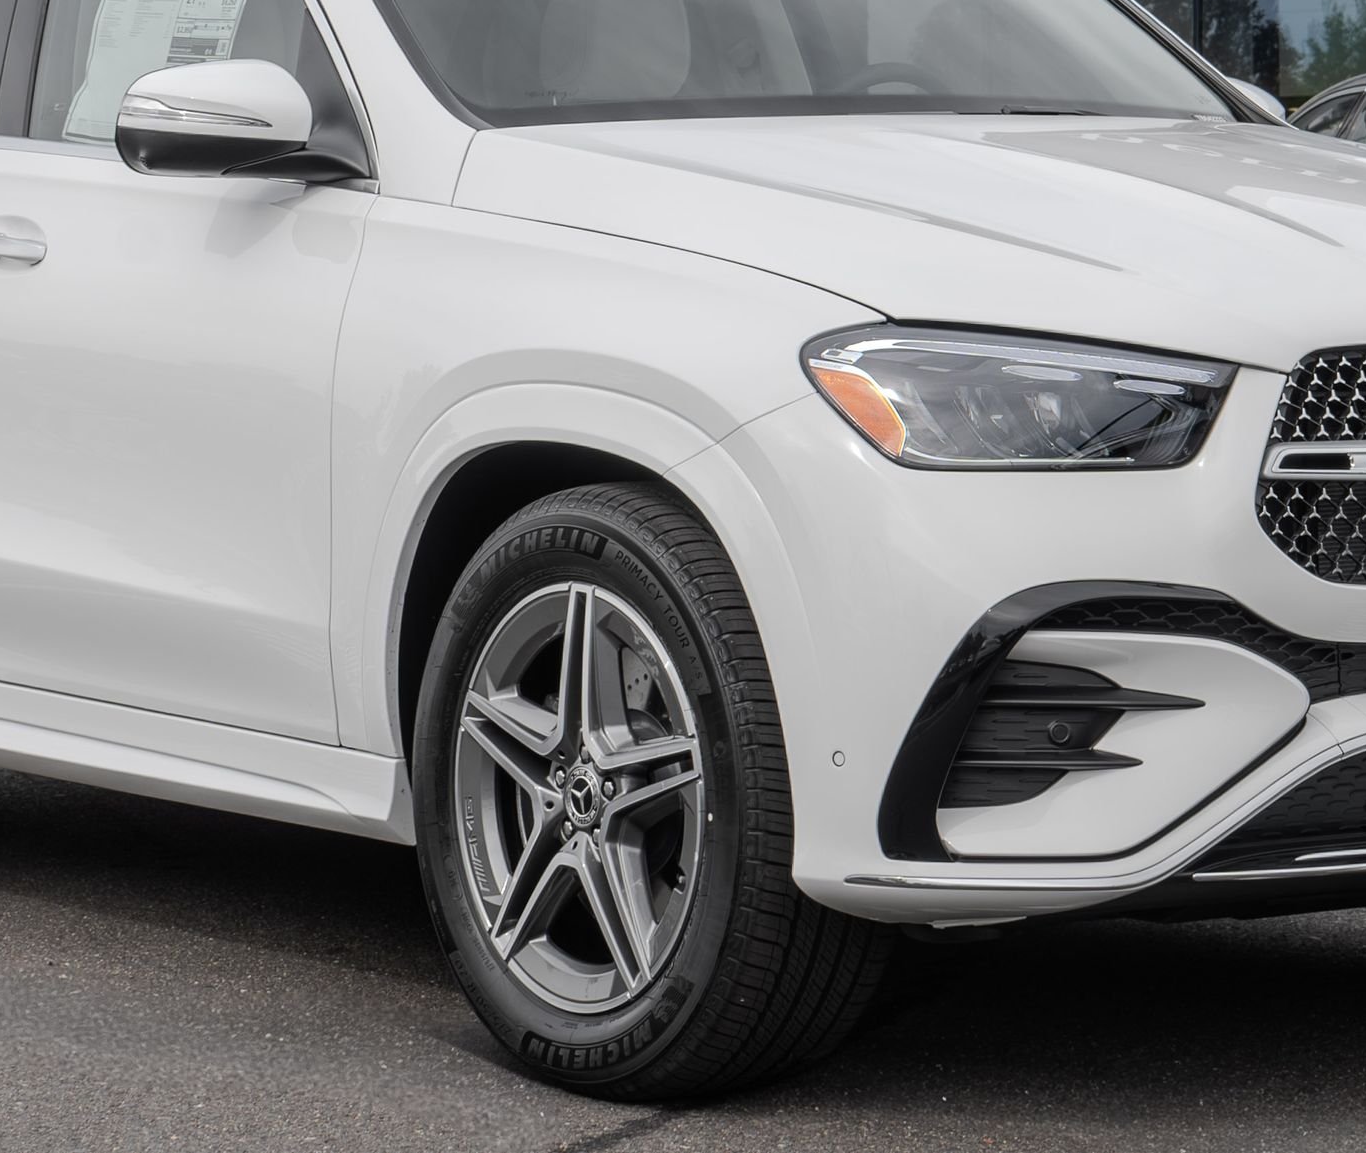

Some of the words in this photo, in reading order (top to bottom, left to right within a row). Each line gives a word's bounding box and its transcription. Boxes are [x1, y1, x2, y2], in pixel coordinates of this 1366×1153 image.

[479, 527, 600, 580] MICHELIN
[614, 550, 664, 601] PRIMACY
[662, 604, 691, 649] TOUR
[527, 1018, 655, 1069] MICHELIN
